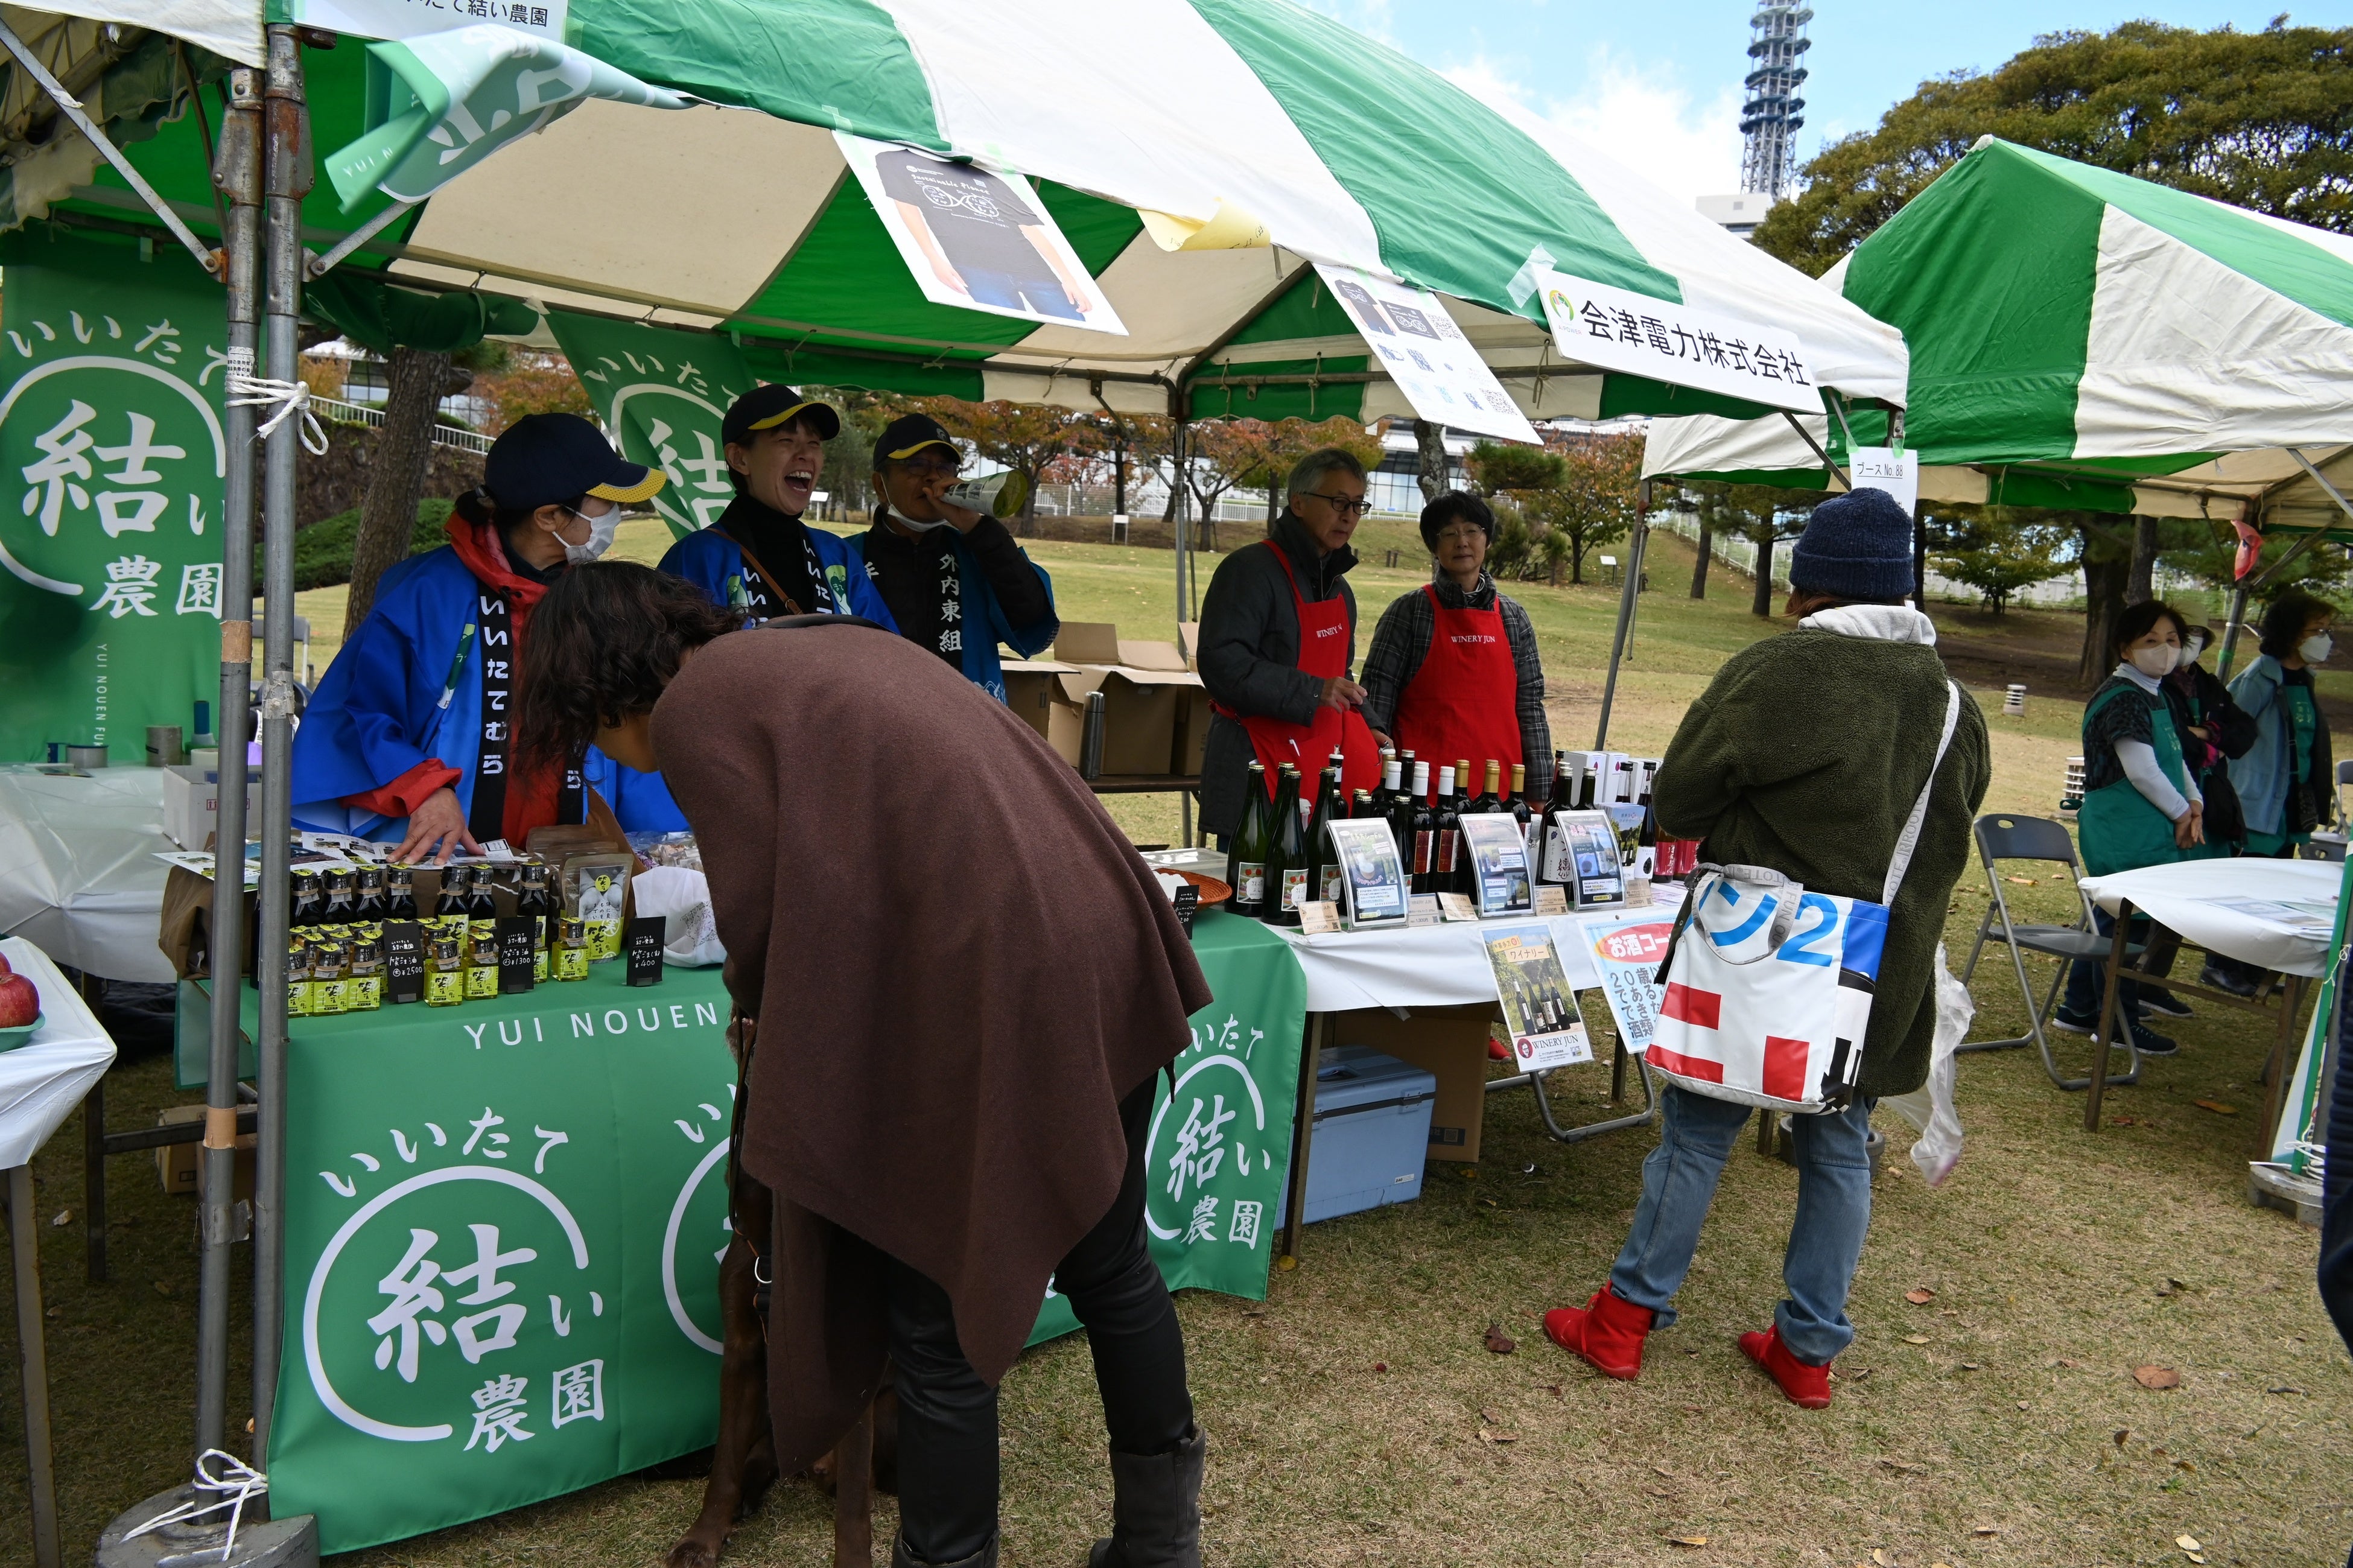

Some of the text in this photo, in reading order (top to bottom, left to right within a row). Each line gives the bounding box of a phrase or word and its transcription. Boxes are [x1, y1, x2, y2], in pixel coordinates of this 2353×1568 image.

[1580, 300, 1811, 387] 会津電力株式会社
[1857, 462, 1903, 477] ブース No. 88
[88, 555, 223, 620] 農園
[939, 553, 962, 652] 外内東組
[97, 643, 107, 667] YUI
[1451, 635, 1496, 644] WINERY JUN
[96, 676, 107, 720] NOUEN
[480, 595, 510, 774] いいたてむら
[635, 960, 655, 968] ¥400
[1510, 948, 1544, 960] ワイナリー
[1613, 985, 1665, 1005] である
[464, 1001, 717, 1050] YUI NOUEN
[1180, 1013, 1263, 1061] いたて
[1532, 1034, 1578, 1050] WINERY JUN
[1627, 1018, 1654, 1039] 酒類
[319, 1106, 568, 1198] いいたて
[1166, 1094, 1271, 1202] 結い
[1180, 1195, 1263, 1250] 農園
[367, 1223, 603, 1383] 結い
[463, 1358, 604, 1453] 農園
